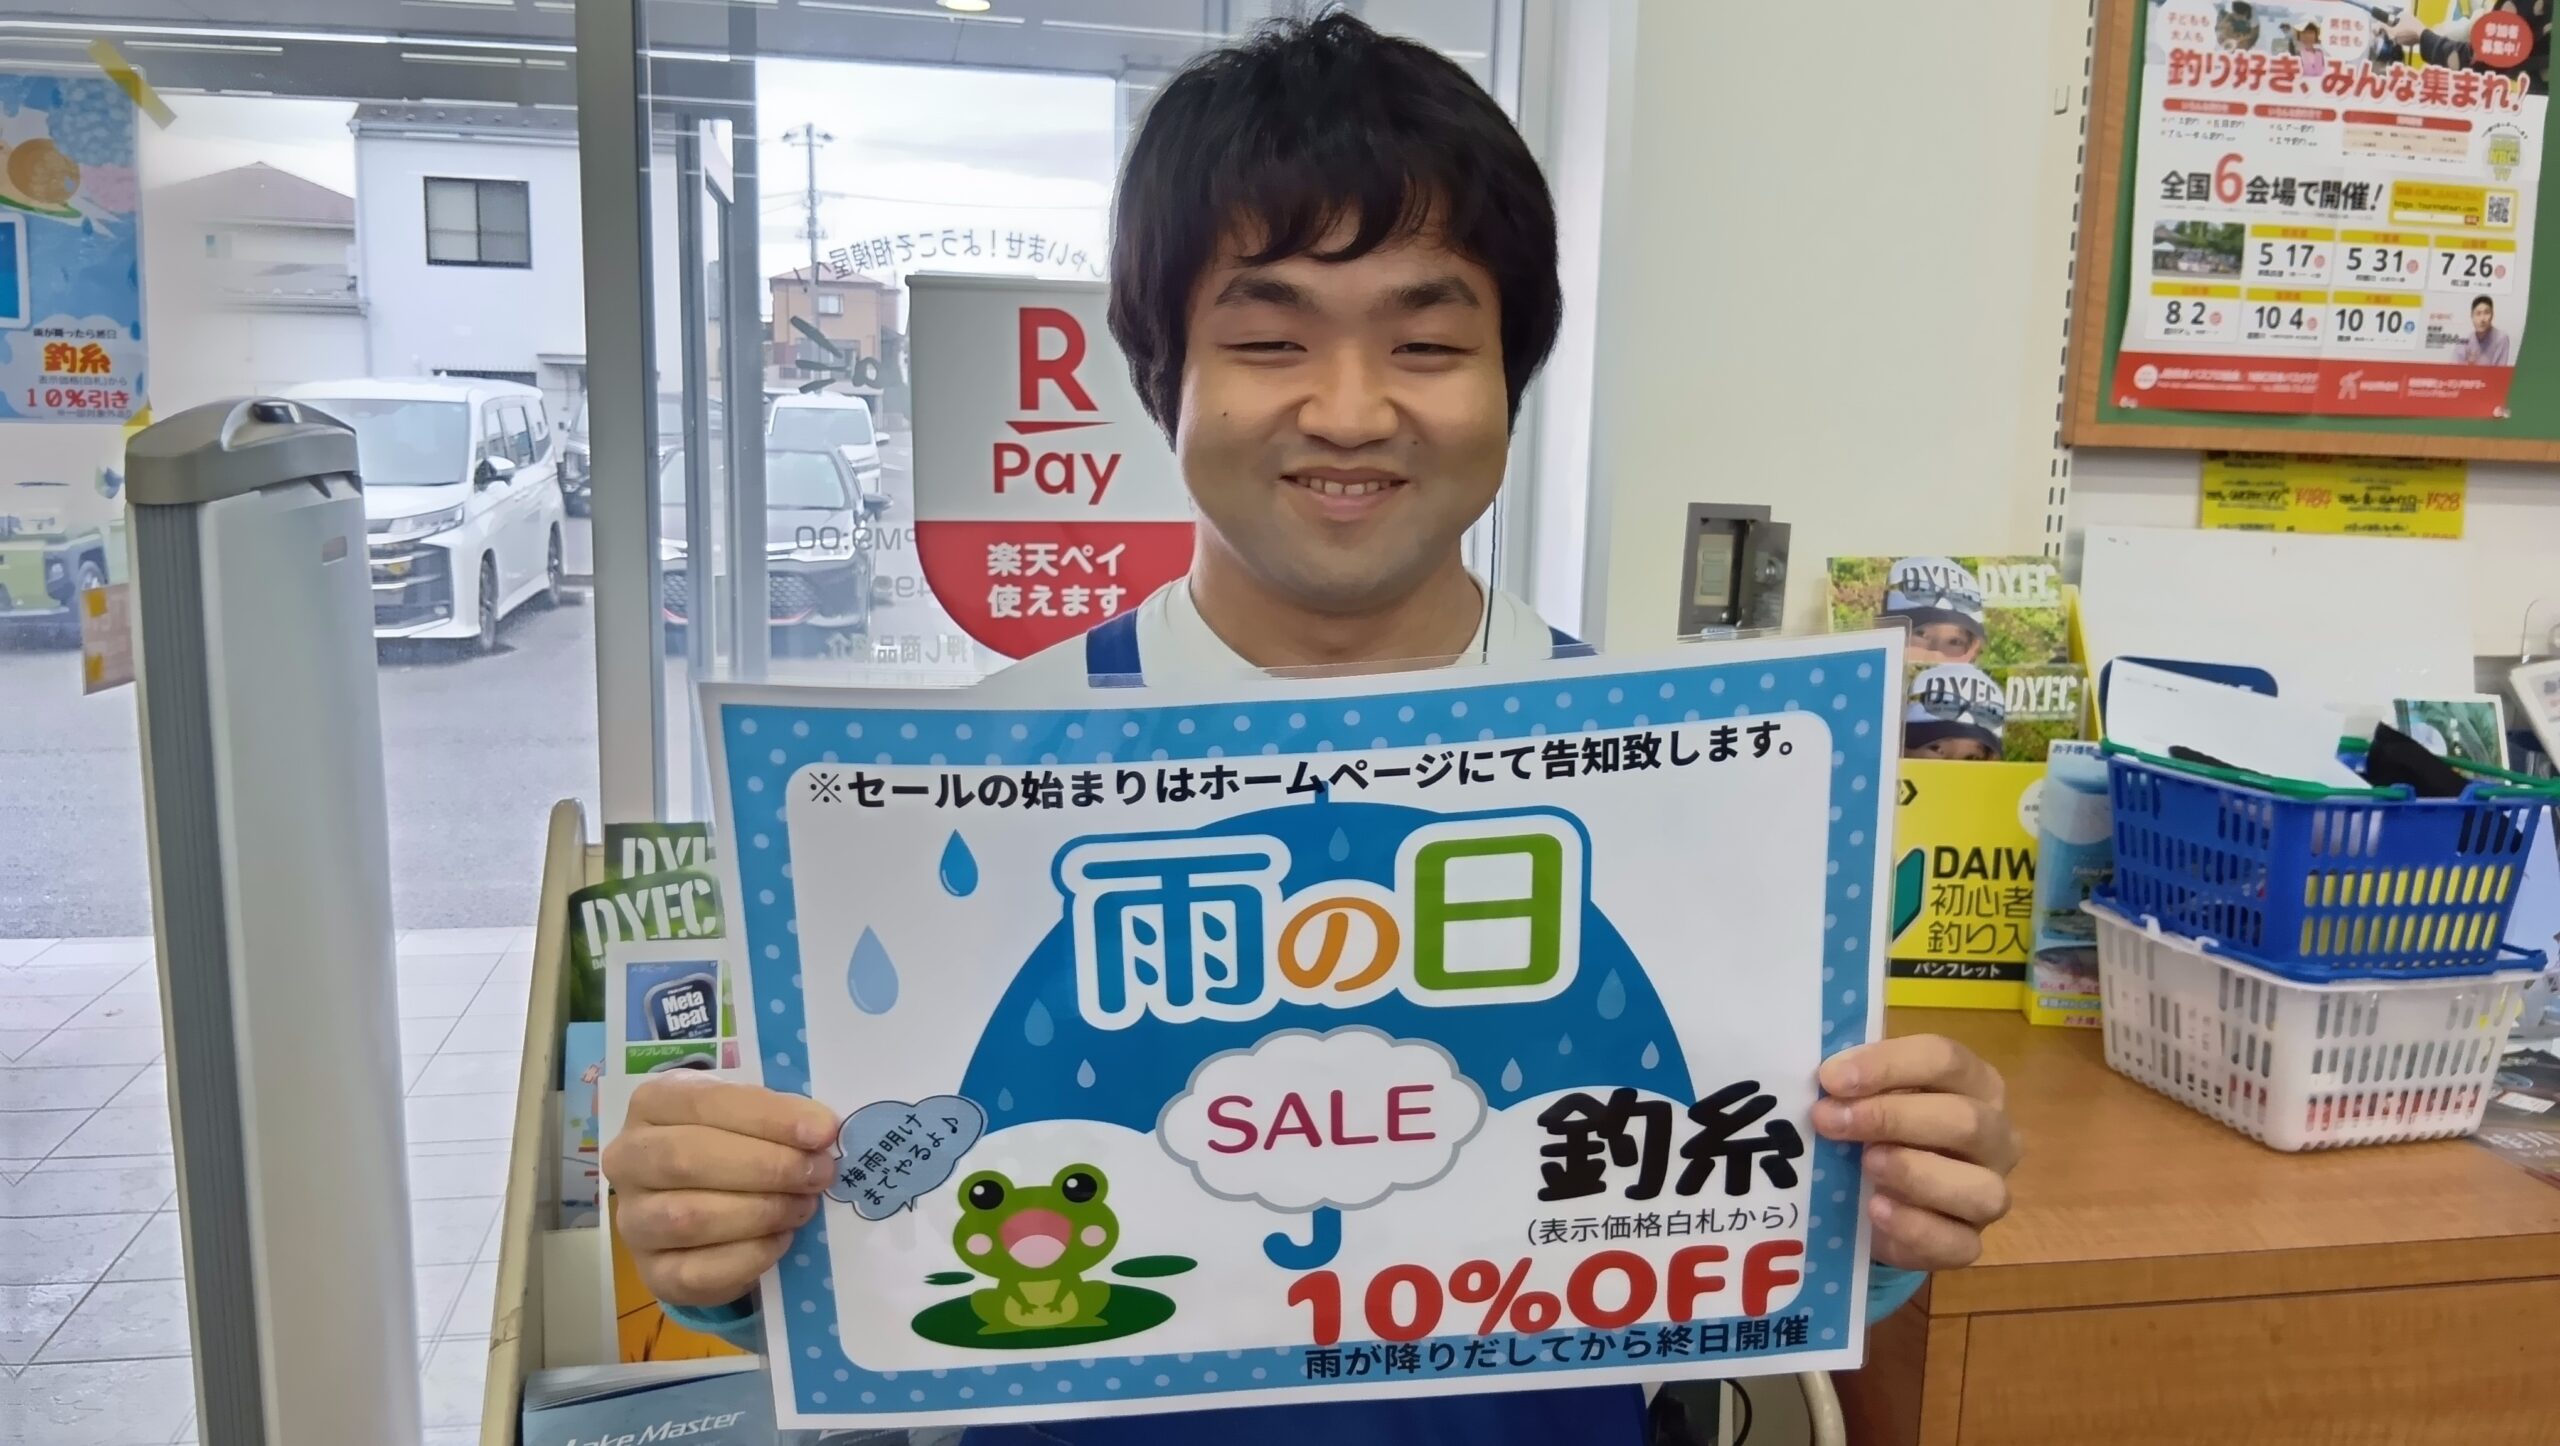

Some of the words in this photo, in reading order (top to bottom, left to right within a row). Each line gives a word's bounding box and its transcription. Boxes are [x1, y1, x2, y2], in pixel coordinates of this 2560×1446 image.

[2168, 12, 2210, 27] 子どもも
[2171, 30, 2204, 43] 大人も
[2330, 18, 2364, 31] 男性も
[2329, 35, 2363, 47] 女性も
[44, 342, 111, 374] 釣糸
[1018, 307, 1099, 411] R
[992, 441, 1122, 506] Pay
[987, 542, 1126, 577] 楽天ペイ
[987, 584, 1127, 618] 使えます
[809, 721, 1794, 810] ※セールの始まりはホームページにて告知致します。
[582, 879, 716, 957] DYEC
[1082, 833, 1563, 1014] 雨の日
[1914, 962, 2001, 979] パンフレット
[662, 991, 705, 1014] Meta
[665, 1005, 710, 1033] beat
[1207, 1084, 1436, 1154] SALE
[840, 1113, 922, 1188] 梅雨明け
[1537, 1080, 1805, 1202] 釣糸
[1287, 1239, 1805, 1346] 10%OFF
[1305, 1314, 1810, 1379] 雨が降りだしてから終日開催
[637, 1411, 746, 1445] Master
